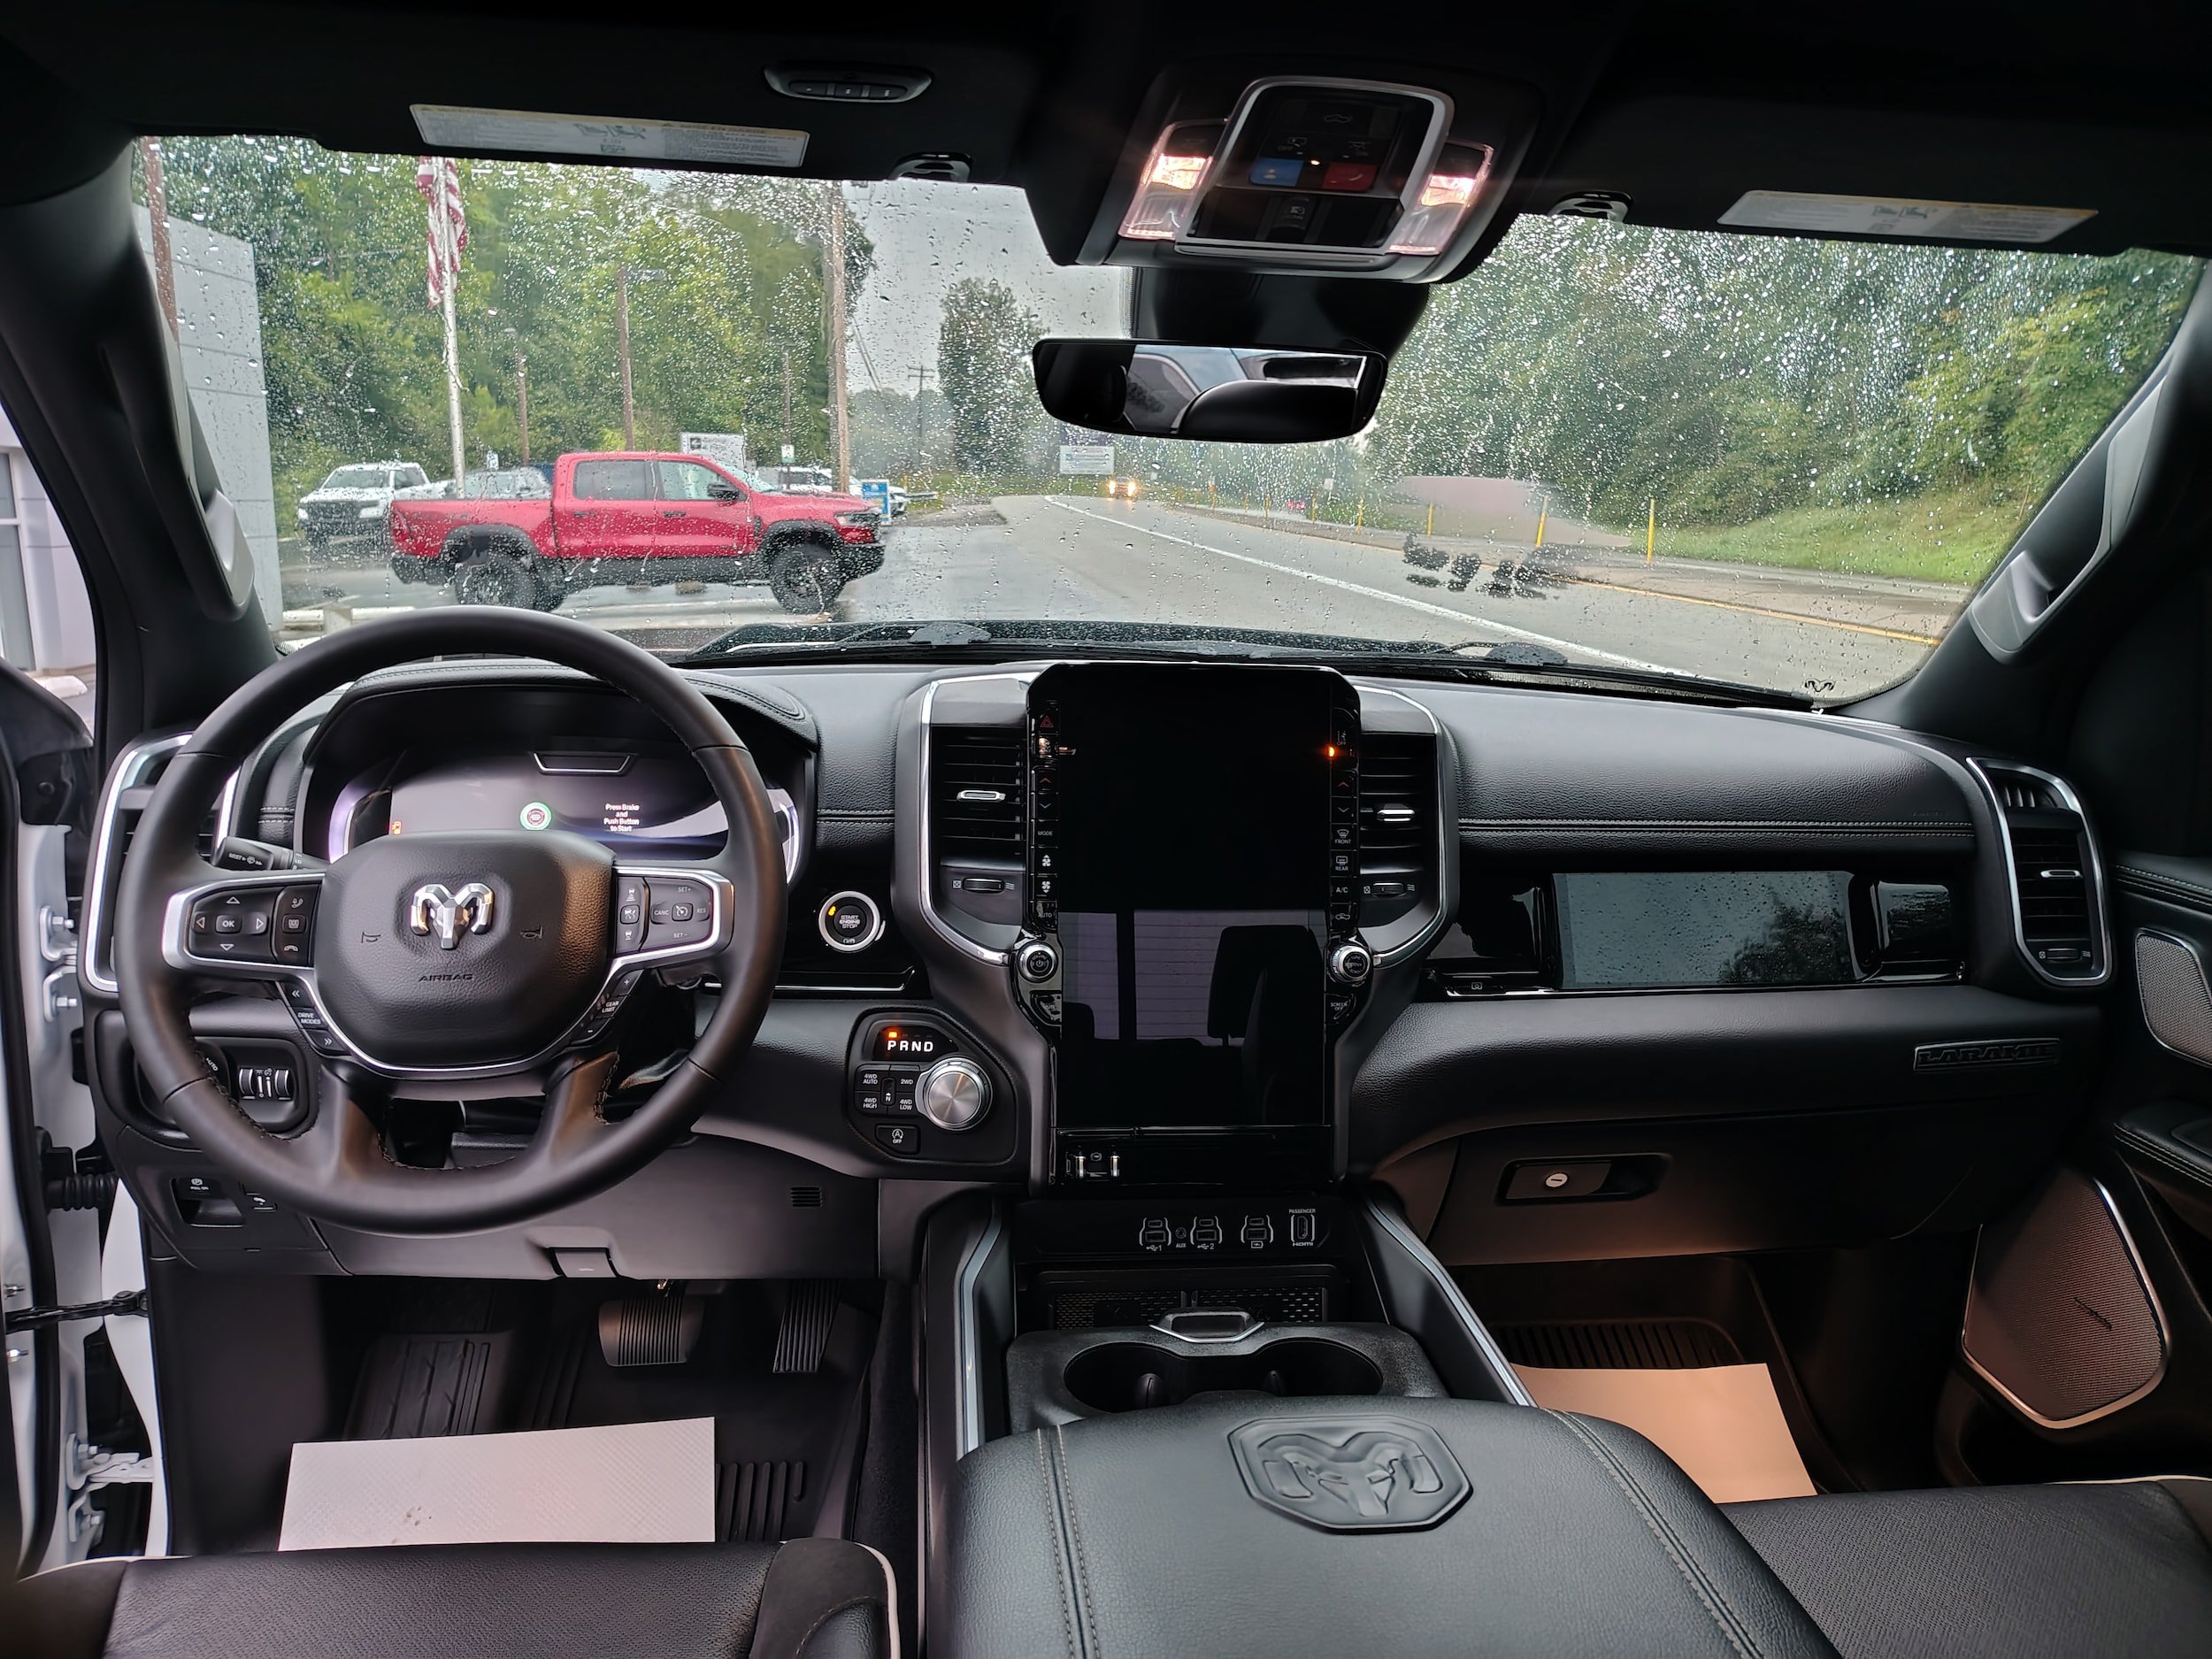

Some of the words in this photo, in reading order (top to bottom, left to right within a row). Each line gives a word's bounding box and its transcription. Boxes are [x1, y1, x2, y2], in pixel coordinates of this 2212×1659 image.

[228, 852, 242, 861] MIST
[418, 973, 473, 982] AIRBAG
[1917, 1043, 2058, 1067] LARAMIE
